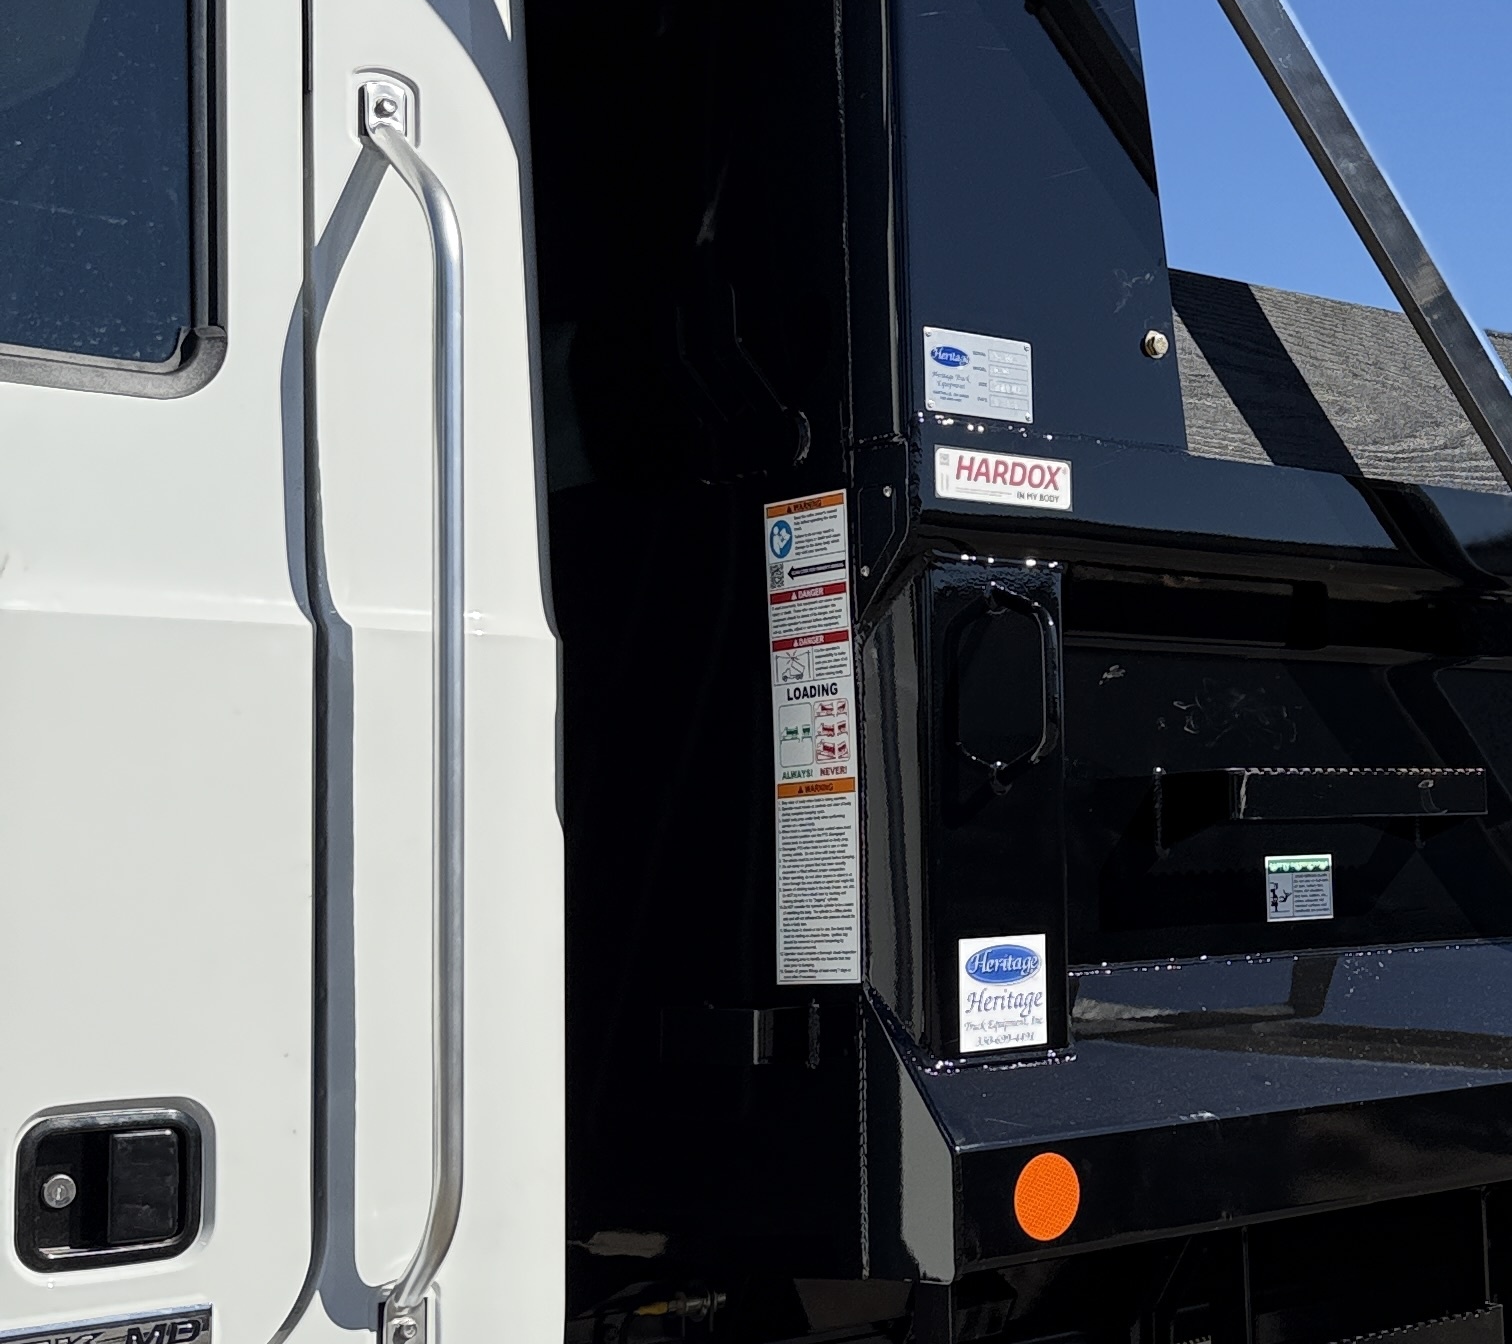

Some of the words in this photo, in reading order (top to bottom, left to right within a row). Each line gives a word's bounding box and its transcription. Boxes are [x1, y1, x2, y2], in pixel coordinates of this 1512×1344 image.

[956, 455, 1061, 491] HARDOX
[787, 682, 838, 701] LOADING
[969, 950, 1038, 976] Heritage
[965, 987, 1043, 1018] Heritage
